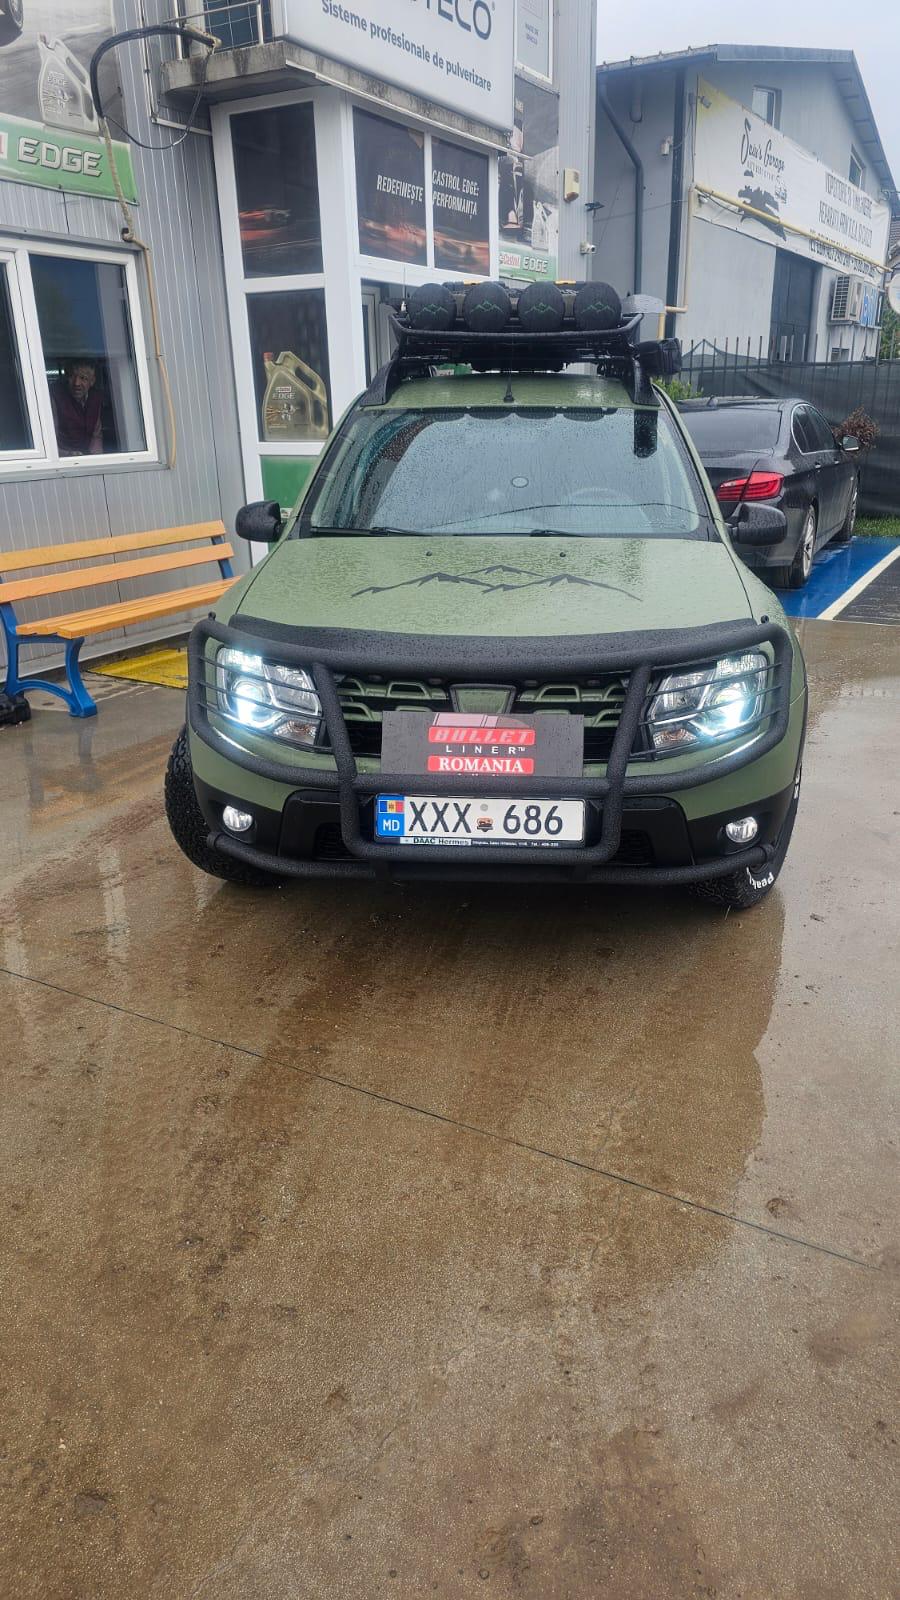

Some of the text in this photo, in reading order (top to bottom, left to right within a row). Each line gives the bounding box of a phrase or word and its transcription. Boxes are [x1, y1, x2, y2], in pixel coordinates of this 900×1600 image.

[322, 0, 491, 92] Sisteme profesionale de pulverizare
[18, 136, 102, 177] EDGE
[432, 170, 460, 191] CASTROL
[523, 256, 548, 273] EDGE
[434, 727, 531, 744] BULLET
[438, 757, 524, 773] ROMANIA
[383, 820, 400, 831] MD
[408, 801, 563, 835] XXX 686
